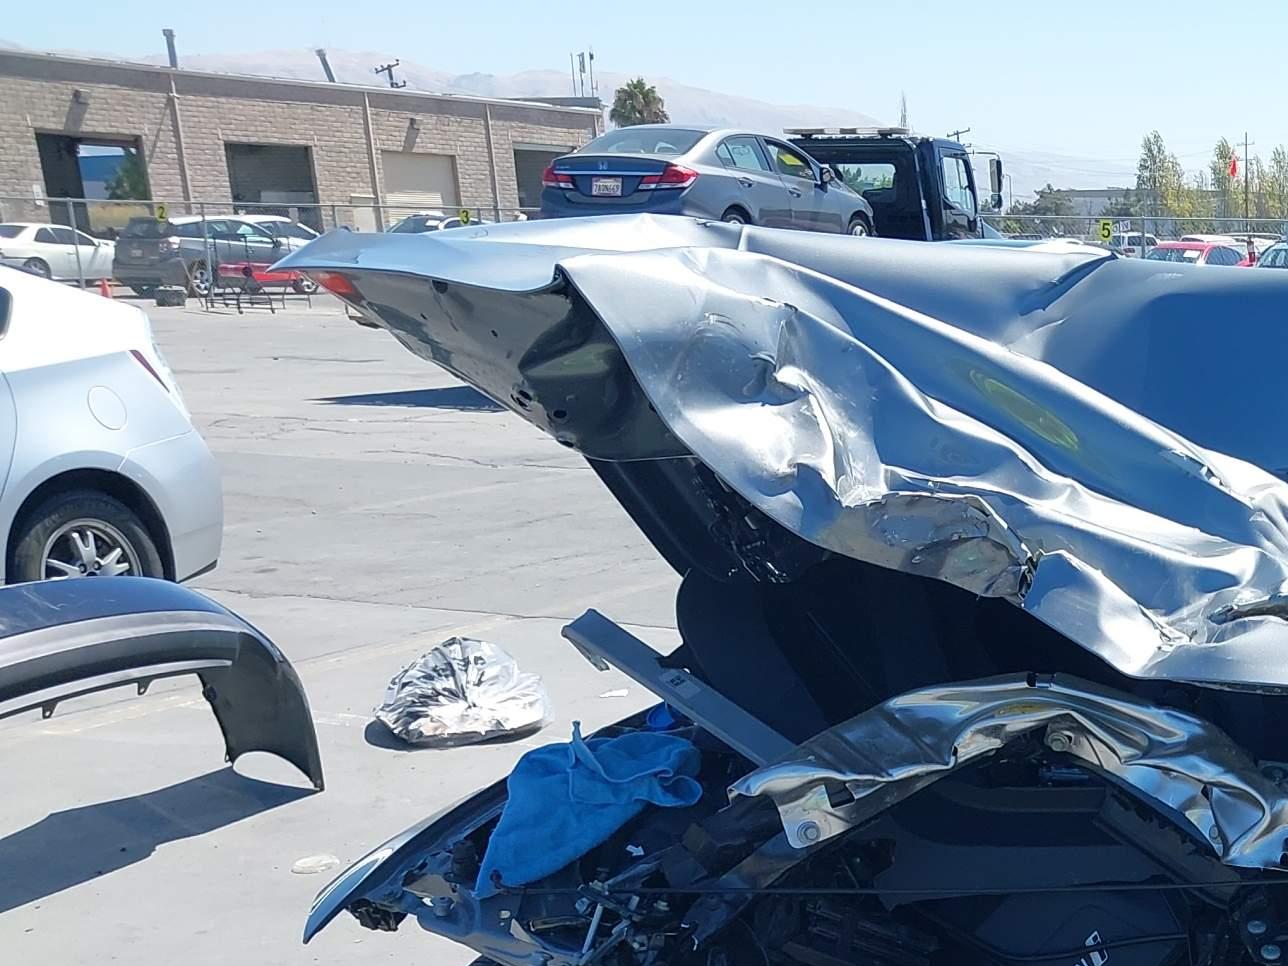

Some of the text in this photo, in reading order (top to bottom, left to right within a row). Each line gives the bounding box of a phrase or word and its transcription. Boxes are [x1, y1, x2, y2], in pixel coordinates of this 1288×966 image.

[158, 206, 166, 219] 2
[461, 209, 469, 224] 3
[1102, 222, 1111, 238] 5
